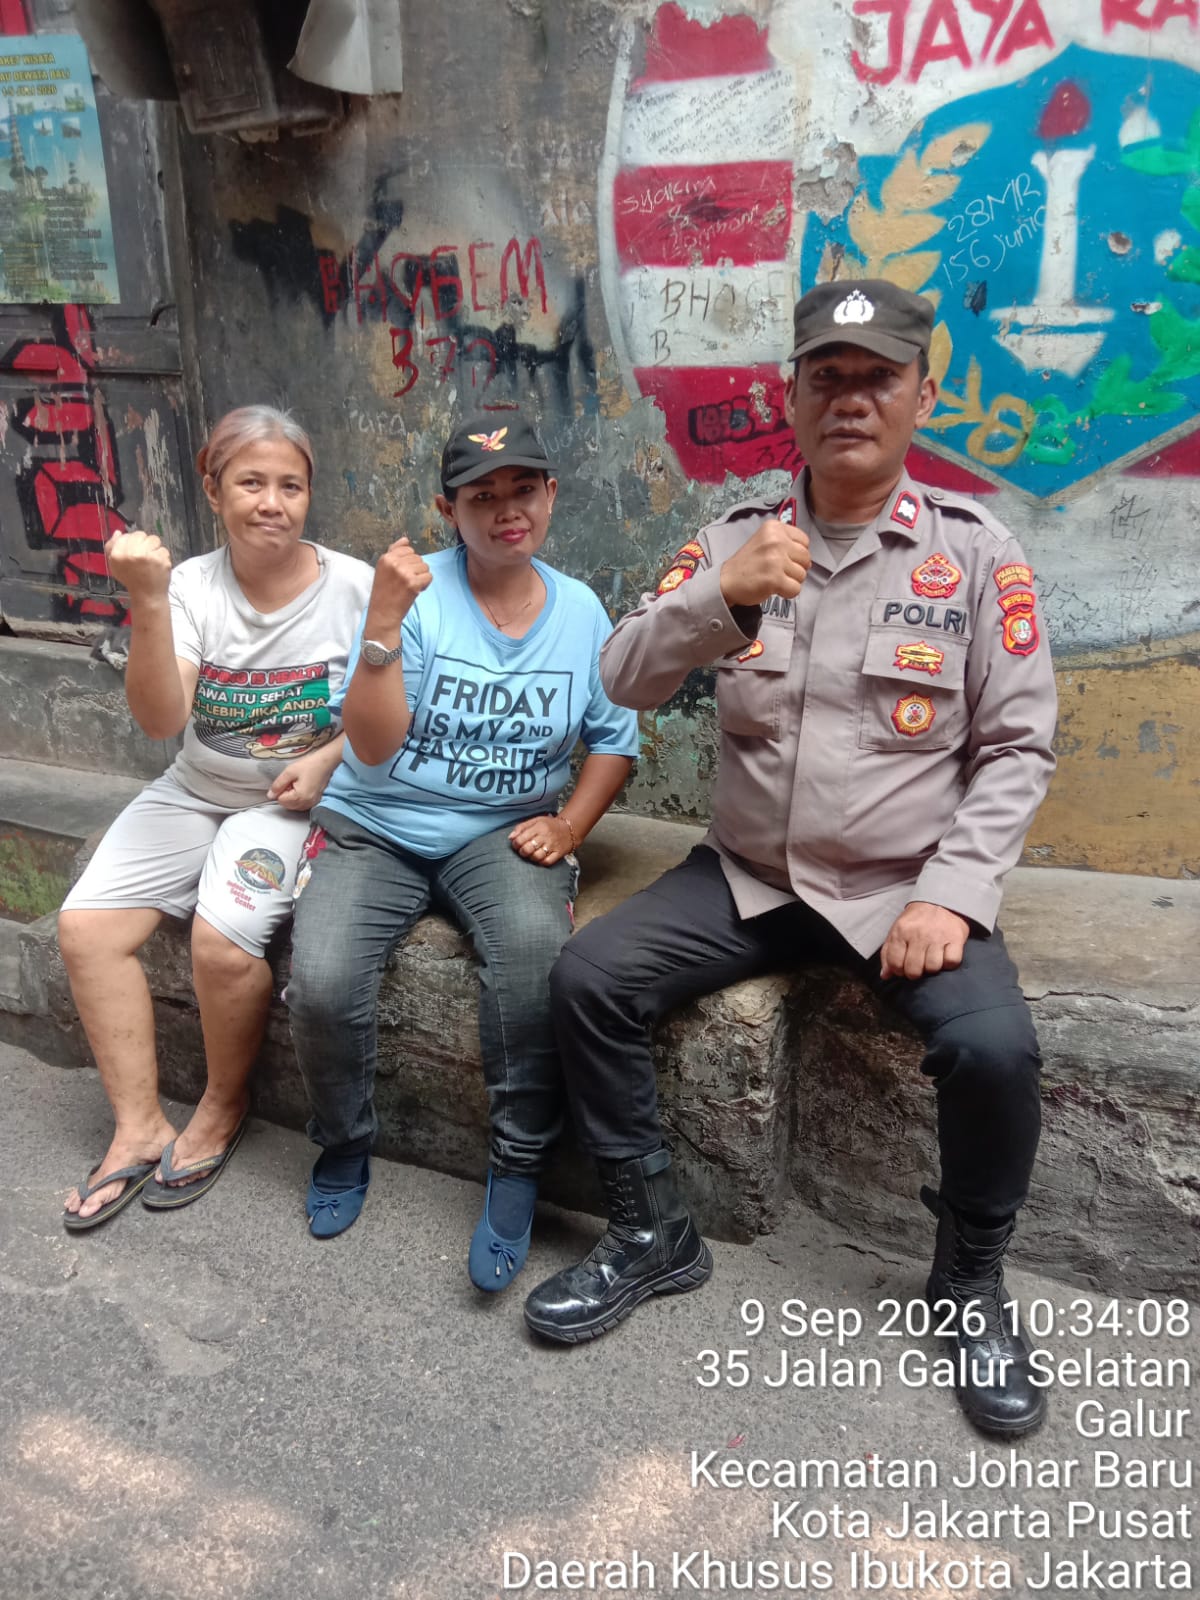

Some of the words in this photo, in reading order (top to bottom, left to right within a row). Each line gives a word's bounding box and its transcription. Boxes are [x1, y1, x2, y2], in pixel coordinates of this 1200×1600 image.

[851, 0, 1056, 85] JAYA
[883, 601, 968, 635] POLRI
[197, 686, 228, 703] AWA
[232, 693, 256, 704] ITU
[260, 685, 303, 704] SEHAT
[248, 706, 279, 719] JIKA
[282, 697, 327, 712] ANDA
[431, 674, 558, 718] FRIDAY
[281, 713, 313, 725] DIRI
[423, 709, 450, 737] IS
[455, 717, 504, 742] MY
[445, 760, 537, 795] WORD
